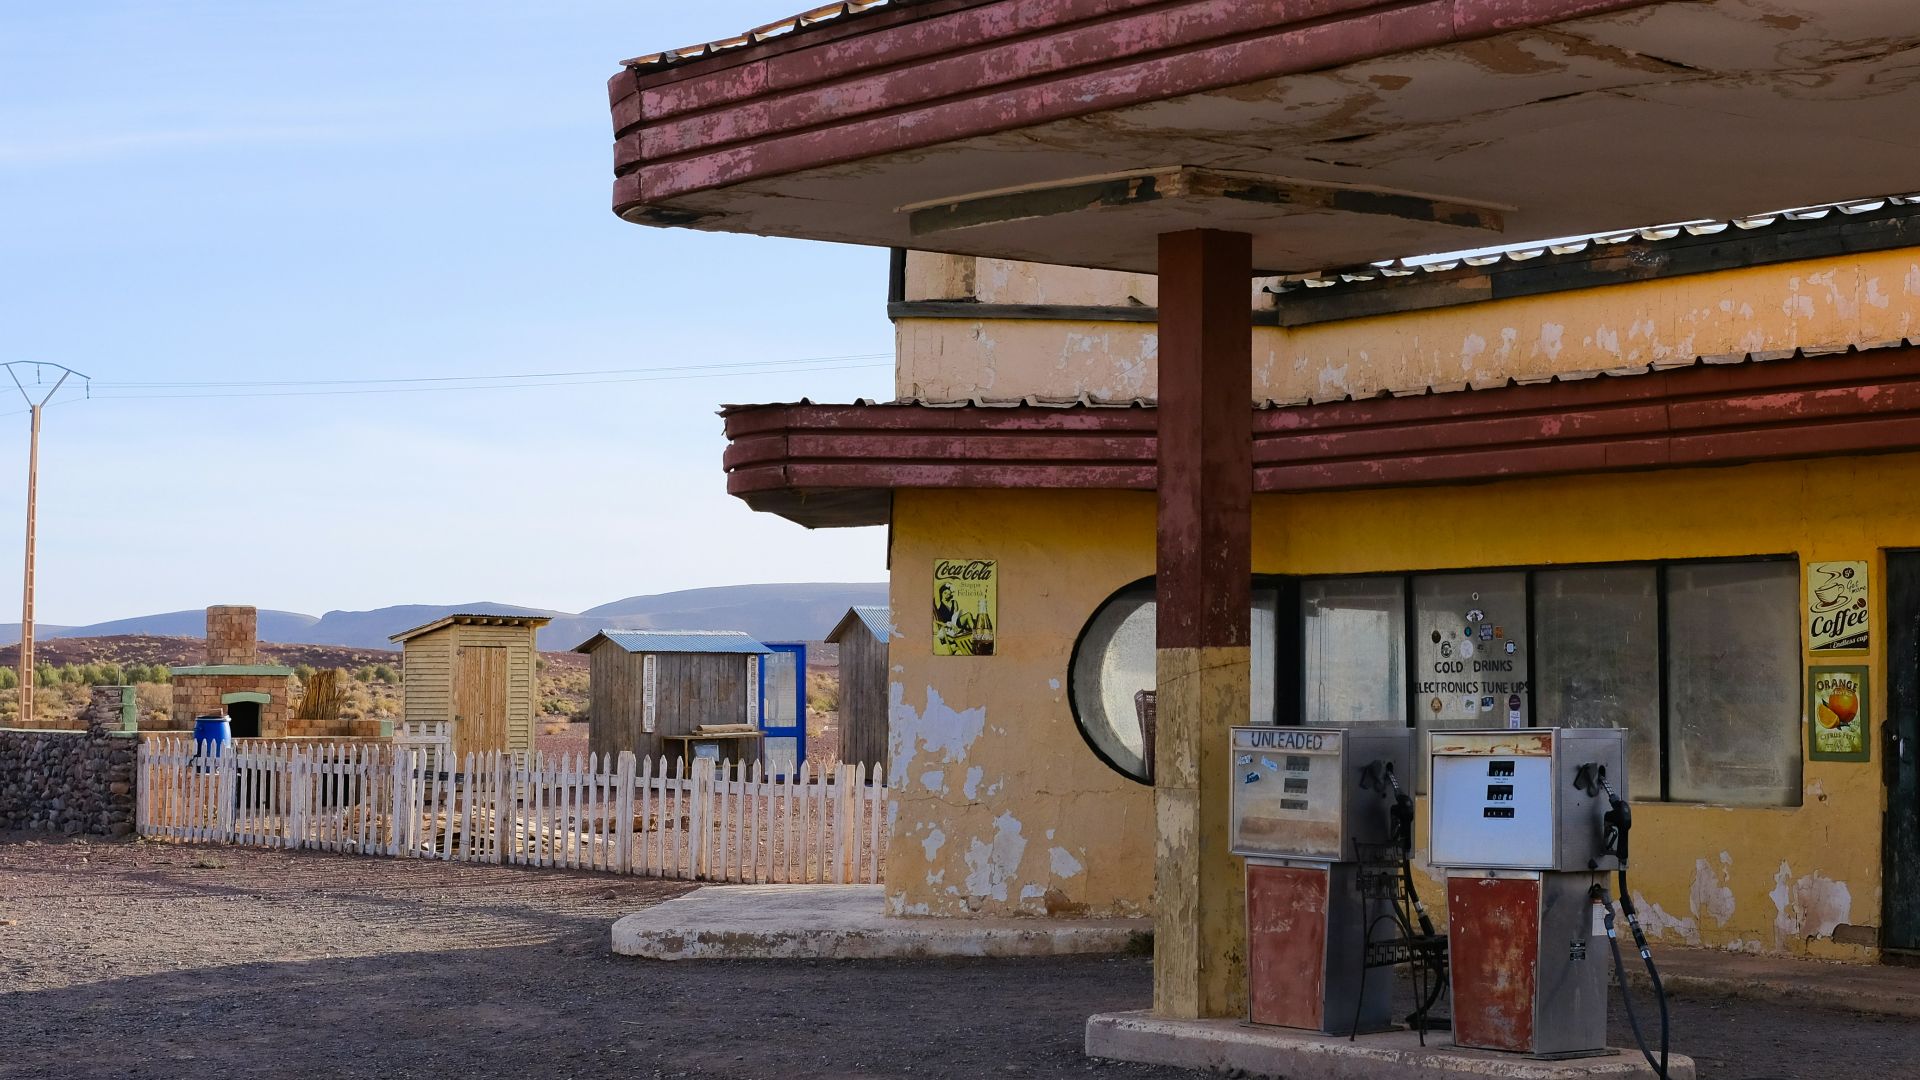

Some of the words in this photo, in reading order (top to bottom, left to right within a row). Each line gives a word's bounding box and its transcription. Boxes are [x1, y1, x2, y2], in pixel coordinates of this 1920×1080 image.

[935, 561, 997, 580] Coca-Cola
[1811, 608, 1869, 638] Coffee
[1832, 638, 1856, 649] Endless
[1856, 635, 1868, 643] cup
[1434, 661, 1463, 673] COLD
[1473, 660, 1513, 673] DRINKS
[1415, 681, 1479, 694] ELECTRONICS
[1481, 681, 1508, 694] TUNE
[1816, 678, 1859, 694] ORANGE
[1251, 731, 1323, 750] UNLEADED
